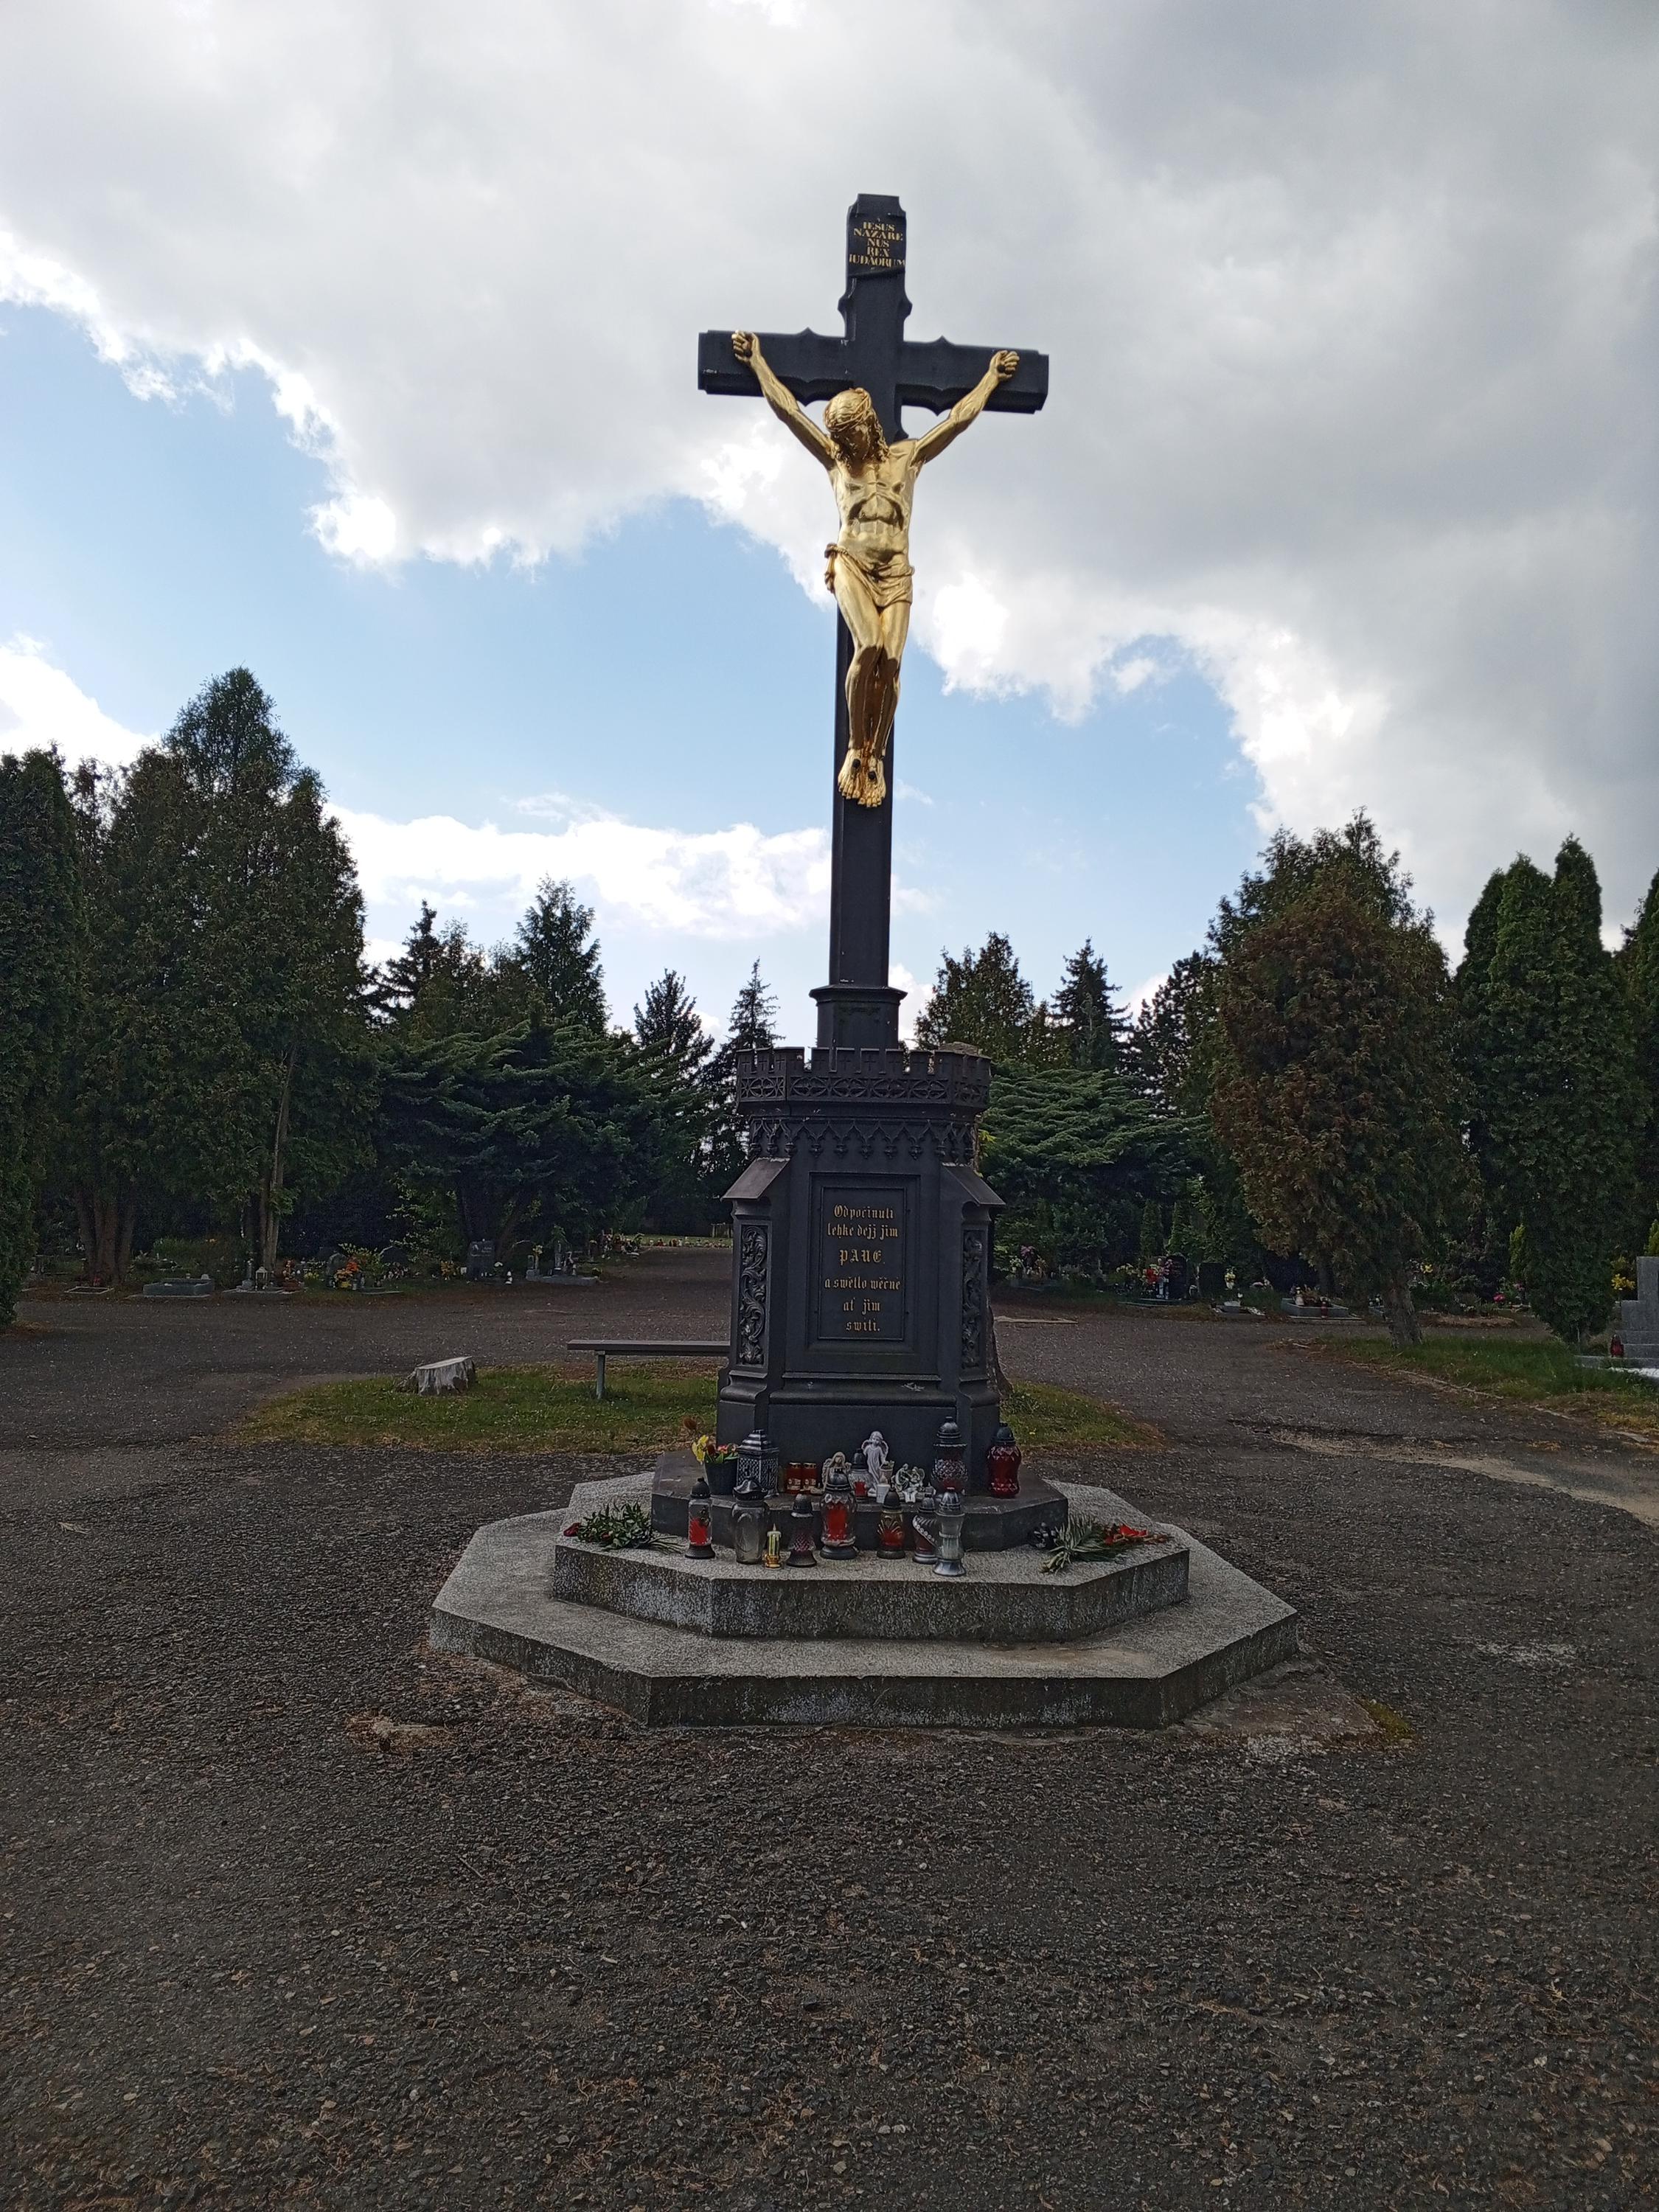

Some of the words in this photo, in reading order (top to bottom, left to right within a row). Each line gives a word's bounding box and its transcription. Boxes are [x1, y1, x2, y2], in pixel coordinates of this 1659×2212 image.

[867, 237, 889, 248] NUS
[866, 246, 890, 257] REX
[880, 1224, 898, 1240] jim
[824, 1278, 831, 1288] a
[861, 1298, 880, 1315] jim
